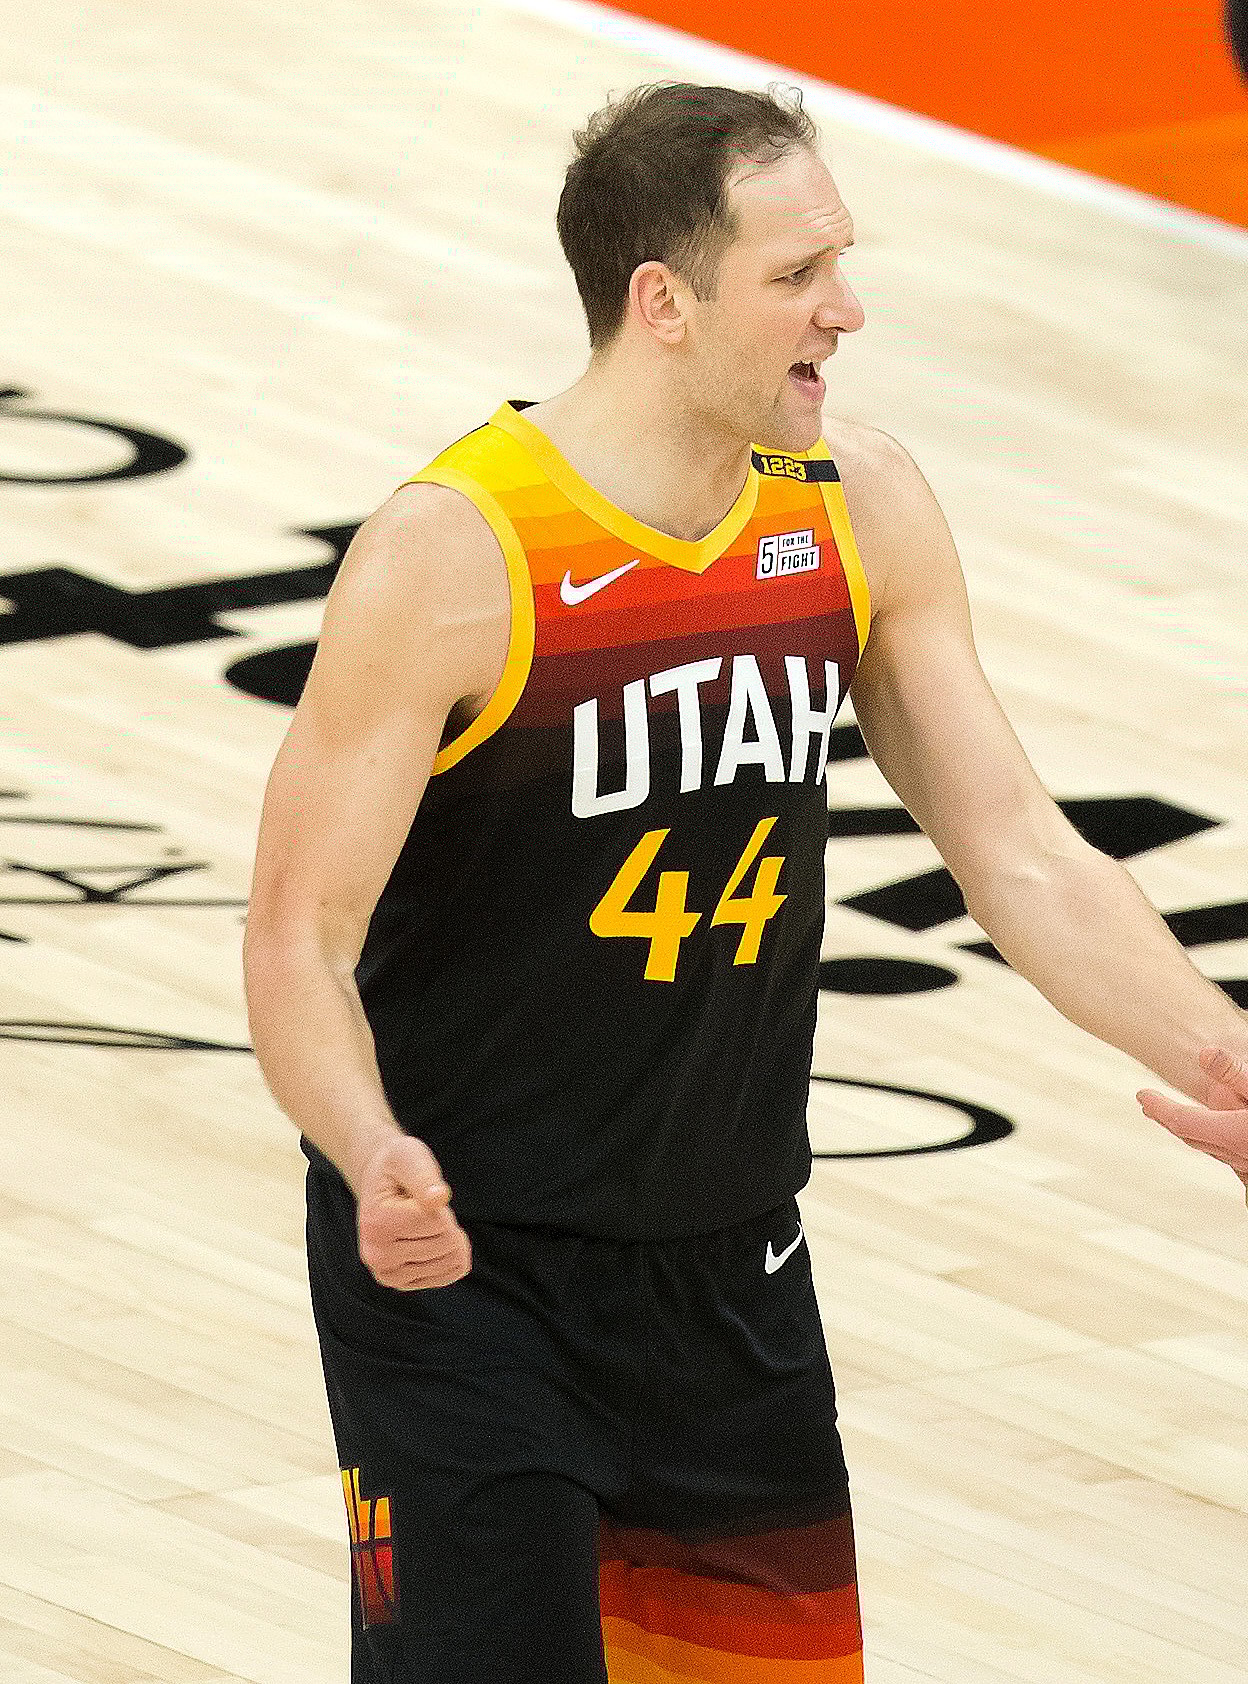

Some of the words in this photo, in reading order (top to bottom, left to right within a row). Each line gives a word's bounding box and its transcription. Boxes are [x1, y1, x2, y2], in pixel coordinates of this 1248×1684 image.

[760, 456, 807, 481] 1223
[782, 537, 795, 548] FOR
[797, 535, 809, 545] THE
[761, 541, 775, 575] 5
[781, 551, 816, 571] FIGHT
[571, 654, 839, 819] UTAH
[589, 816, 788, 983] 44
